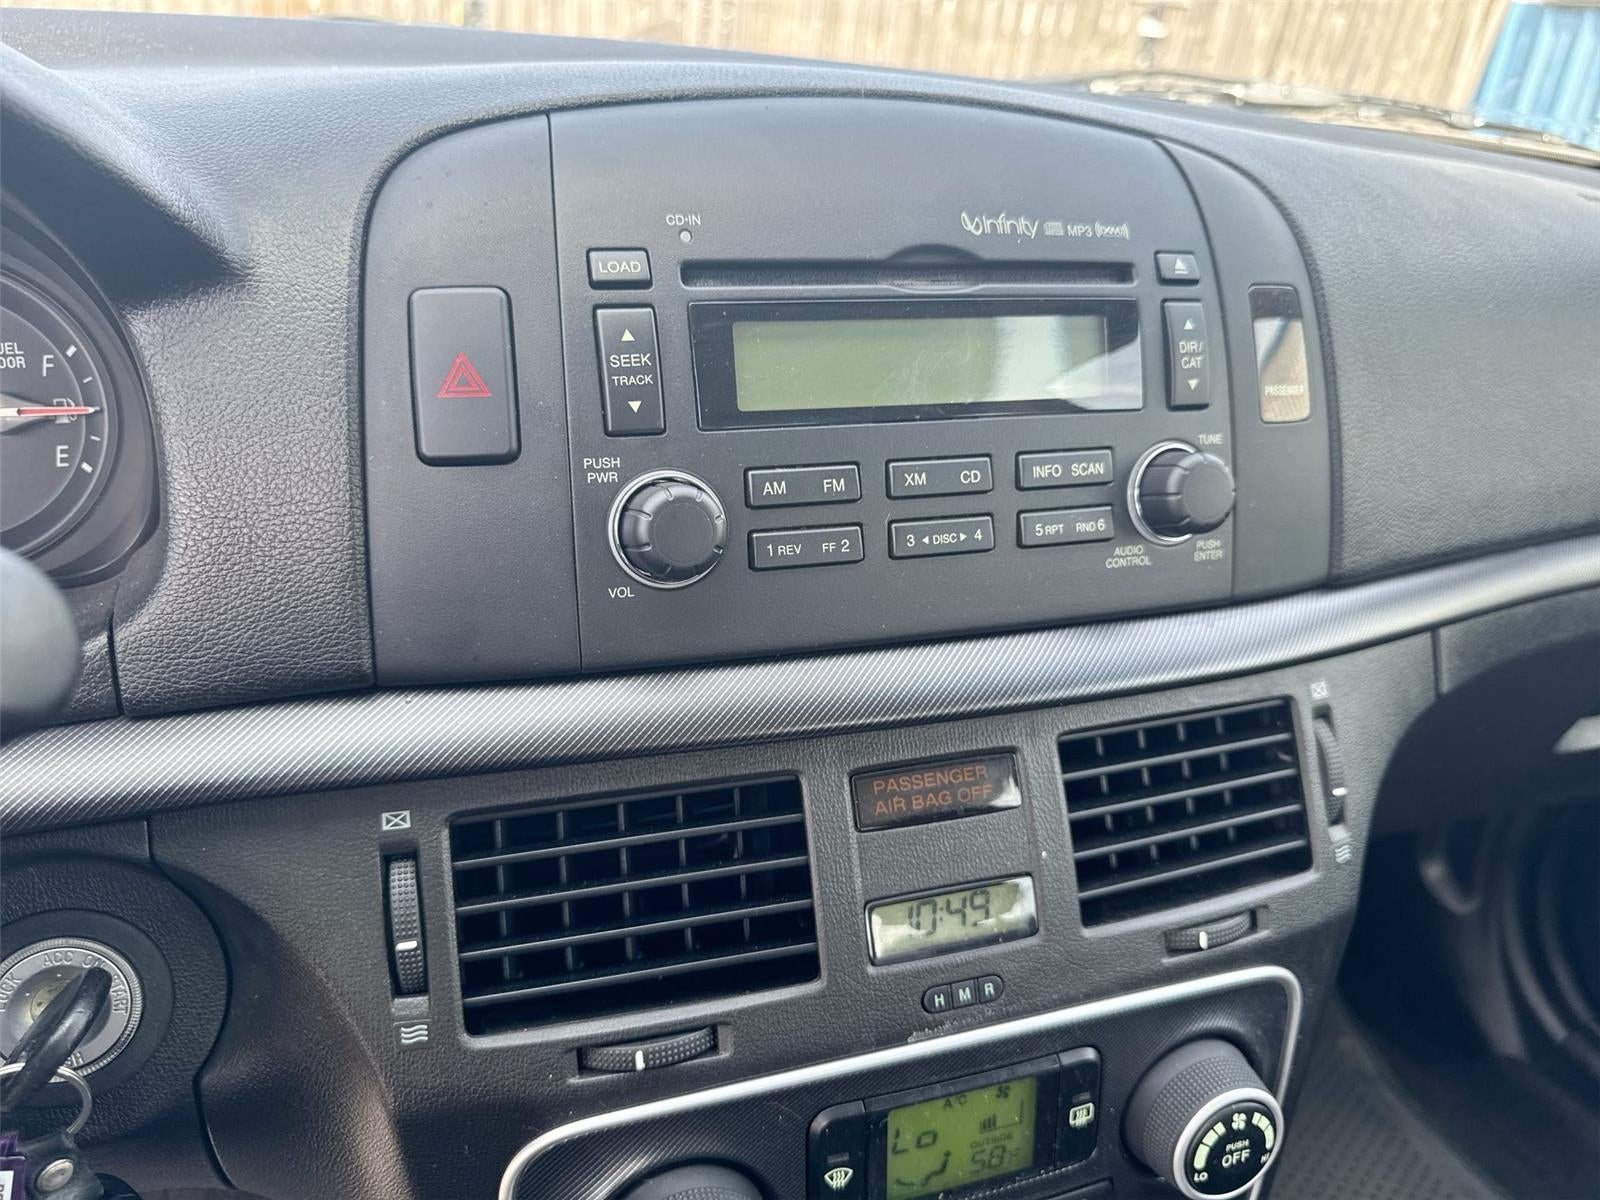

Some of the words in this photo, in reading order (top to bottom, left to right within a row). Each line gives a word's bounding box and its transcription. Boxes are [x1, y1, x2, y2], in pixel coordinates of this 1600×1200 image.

[1067, 223, 1093, 238] MP3
[599, 260, 642, 275] LOAD
[0, 341, 24, 355] UEL
[0, 356, 26, 369] OOR
[41, 354, 55, 377] F
[609, 353, 652, 368] SEEK
[1181, 356, 1204, 369] CAT
[611, 374, 654, 387] TRACK
[1198, 433, 1224, 445] TUNE
[55, 445, 70, 467] E
[583, 457, 621, 470] PUSH
[587, 472, 619, 484] PWR
[1032, 463, 1063, 479] INFO
[1071, 462, 1105, 476] SCAN
[904, 472, 927, 487] XM
[960, 470, 981, 484] CD
[762, 481, 787, 496] AM
[823, 478, 846, 493] FM
[1035, 523, 1044, 537] 5
[1045, 524, 1065, 536] RPT
[1075, 521, 1097, 533] RND
[1097, 519, 1106, 532] 6
[906, 534, 916, 548] 3
[932, 532, 958, 545] DISC
[973, 528, 983, 542] 4
[1195, 539, 1221, 549] PUSH
[766, 543, 774, 557] 1
[777, 543, 802, 556] REV
[822, 542, 836, 553] FF
[840, 538, 851, 553] 2
[1113, 544, 1144, 556] AUDIO
[1105, 556, 1152, 569] CONTROL
[1193, 551, 1223, 562] ENTER
[608, 586, 635, 599] VOL
[872, 765, 989, 796] PASSENGER
[875, 796, 907, 816] AIR
[911, 791, 953, 810] BAG
[957, 784, 993, 804] OFF
[907, 888, 991, 937] 10:49
[42, 951, 74, 969] ACC
[110, 975, 127, 1015] START
[934, 993, 945, 1008] H
[958, 987, 971, 1002] M
[984, 982, 995, 996] R
[1226, 1138, 1250, 1152] PUSH
[1221, 1149, 1251, 1168] OFF
[1193, 1171, 1208, 1183] LO
